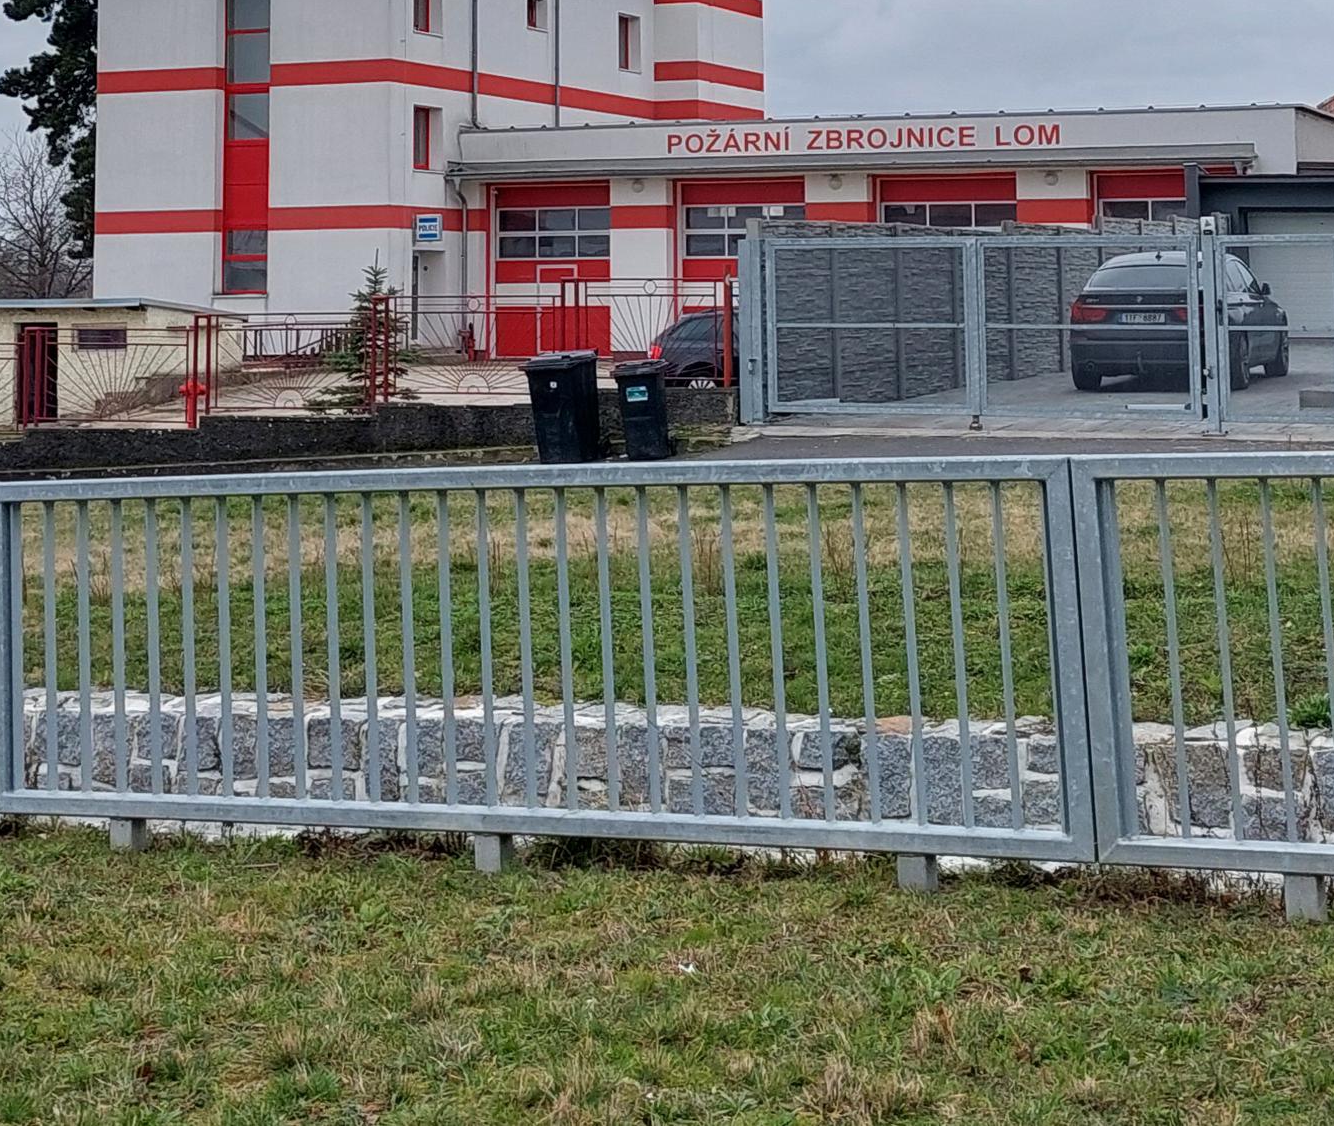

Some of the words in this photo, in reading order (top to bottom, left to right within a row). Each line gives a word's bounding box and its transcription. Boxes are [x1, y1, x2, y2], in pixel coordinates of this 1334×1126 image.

[667, 126, 790, 154] POŽÁRNÍ
[806, 126, 976, 150] ZBROJNICE
[995, 124, 1060, 146] LOM
